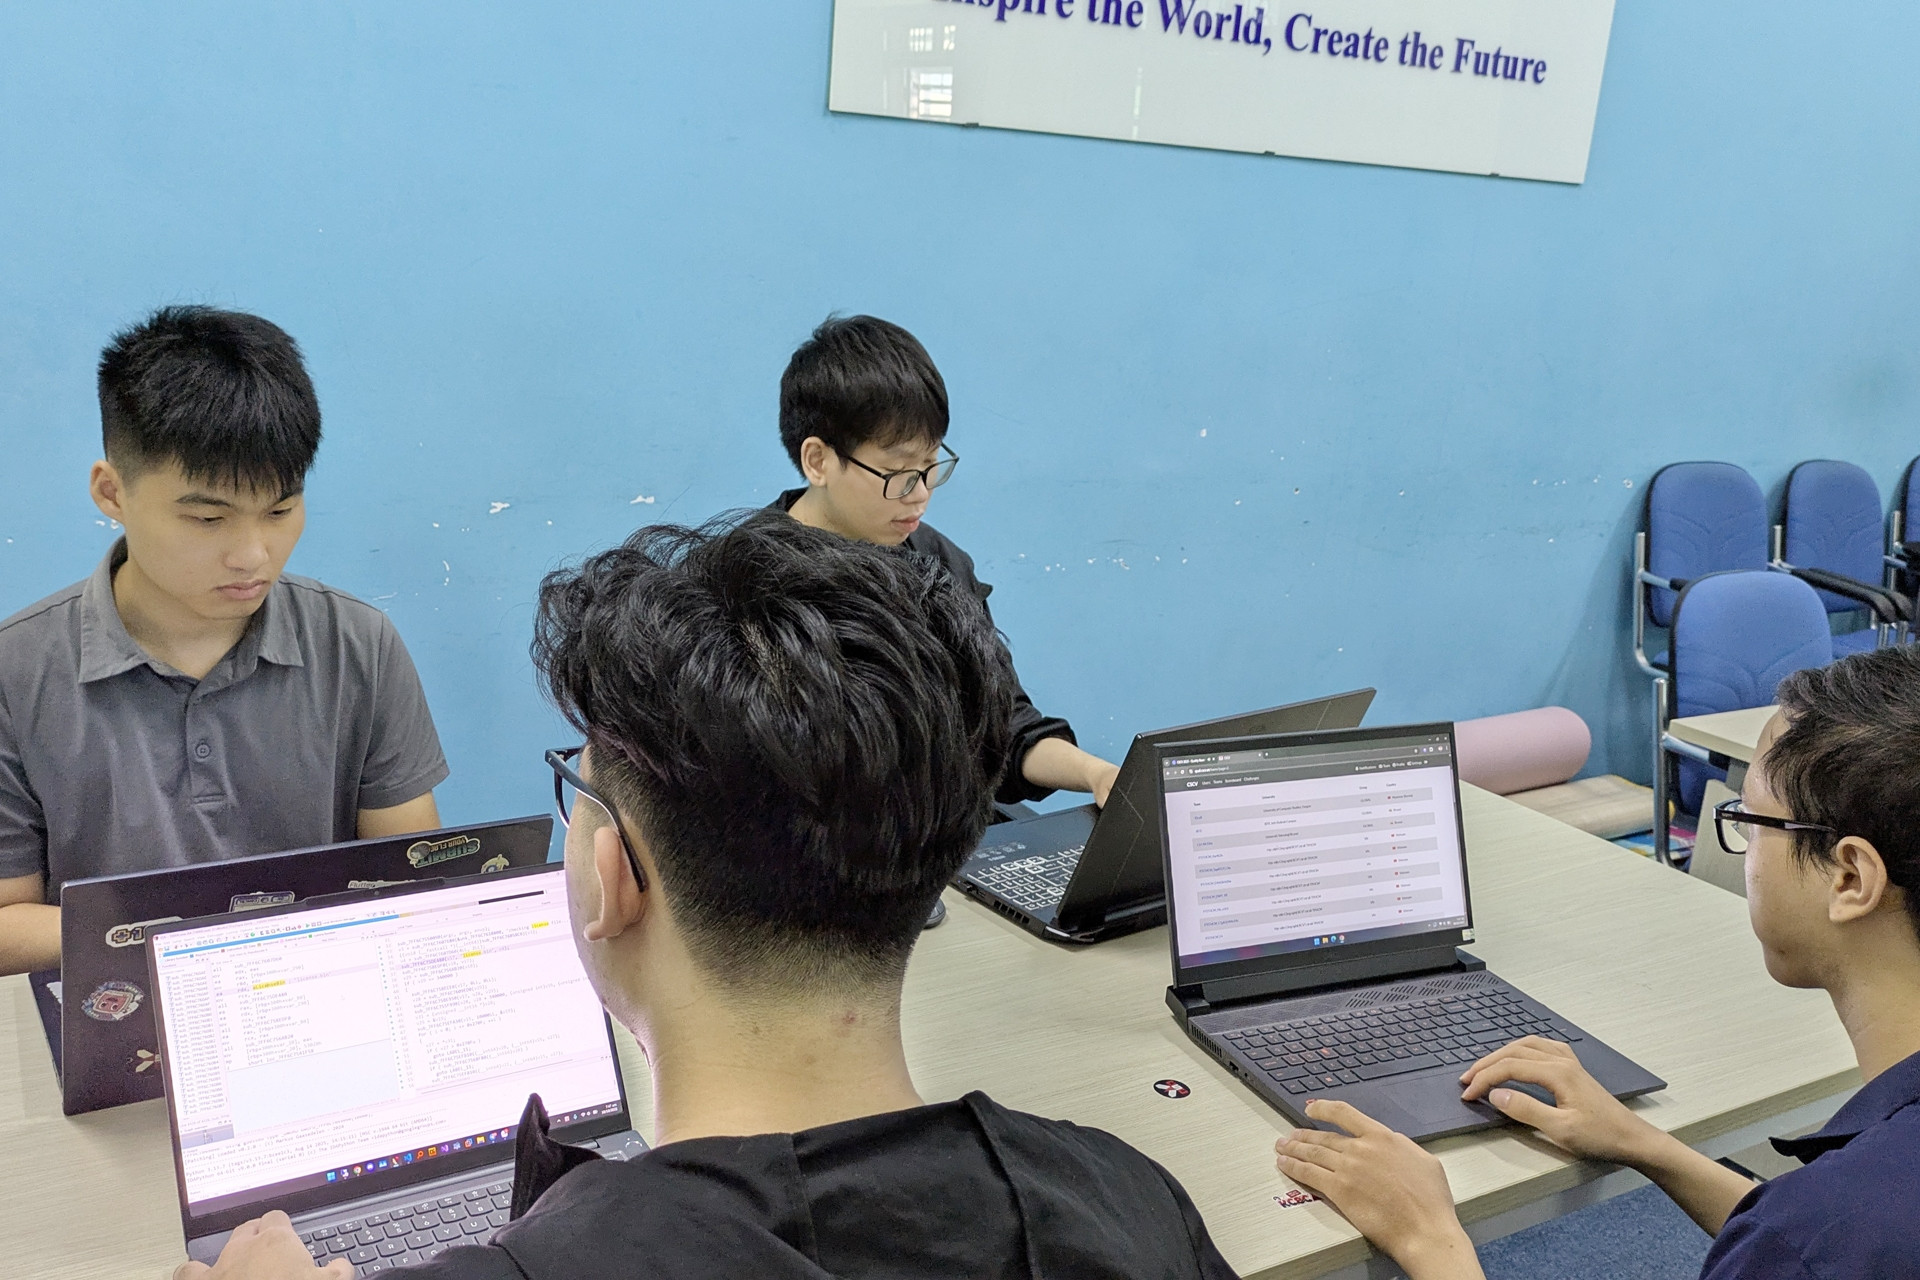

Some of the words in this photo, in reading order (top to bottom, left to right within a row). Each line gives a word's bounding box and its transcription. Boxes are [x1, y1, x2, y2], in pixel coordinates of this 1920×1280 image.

[1087, 0, 1144, 28] the
[1158, 0, 1272, 54] World,
[1284, 13, 1389, 63] Create
[1398, 32, 1444, 71] the
[1452, 37, 1547, 85] Future
